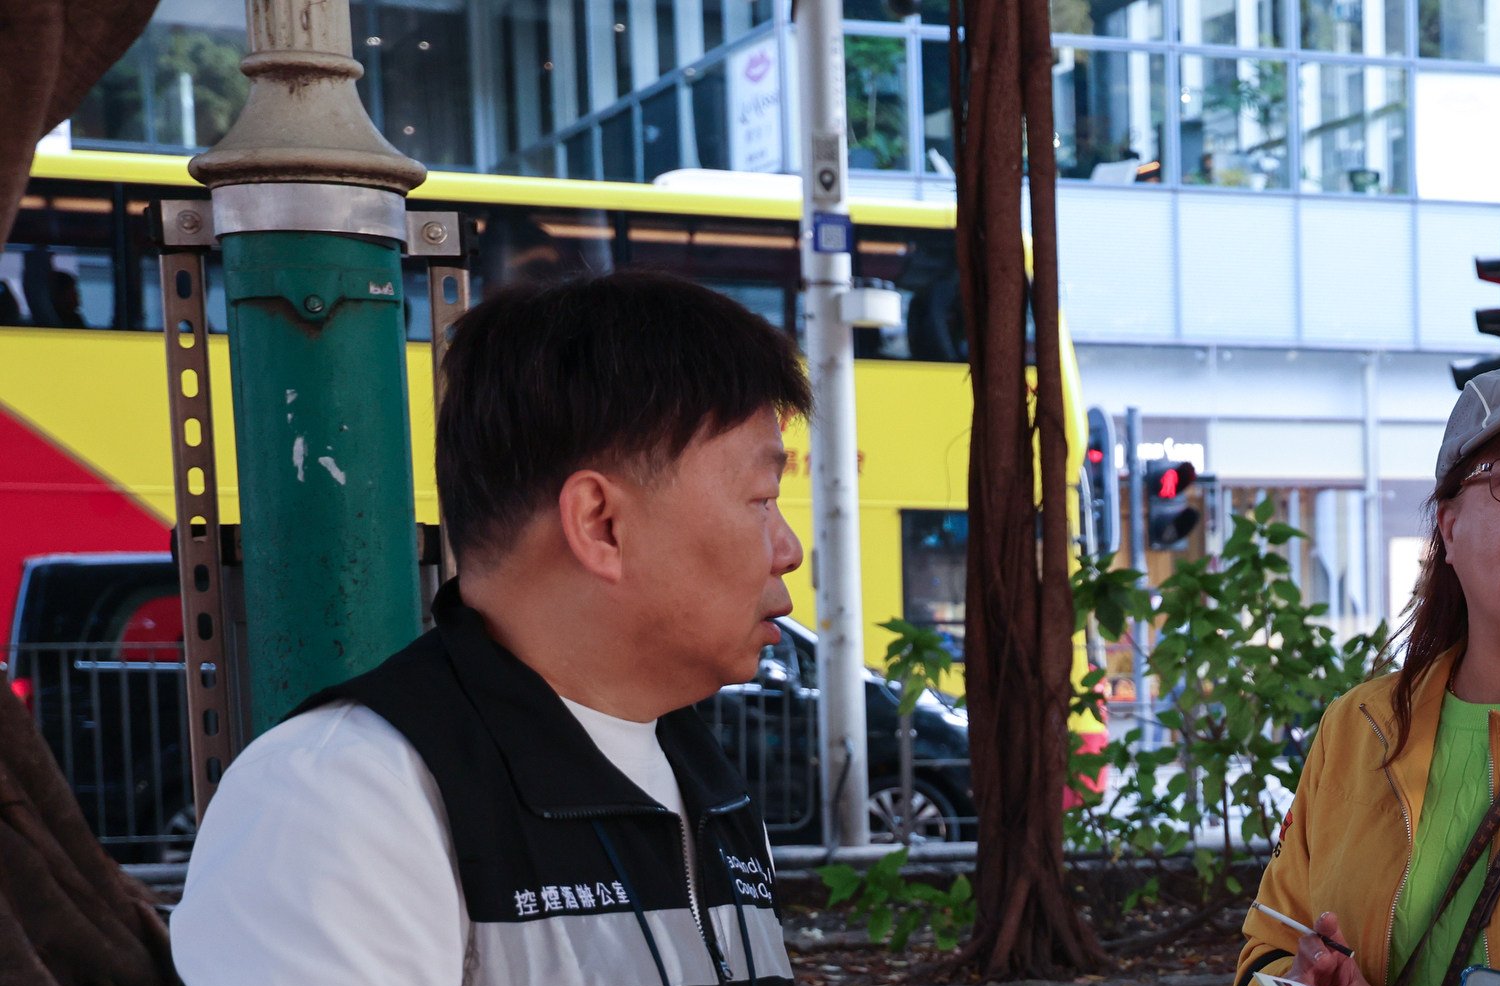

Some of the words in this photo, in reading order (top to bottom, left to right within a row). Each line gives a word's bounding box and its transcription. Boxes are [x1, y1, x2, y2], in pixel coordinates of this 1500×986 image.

[514, 880, 631, 917] 控煙酒辦公室
